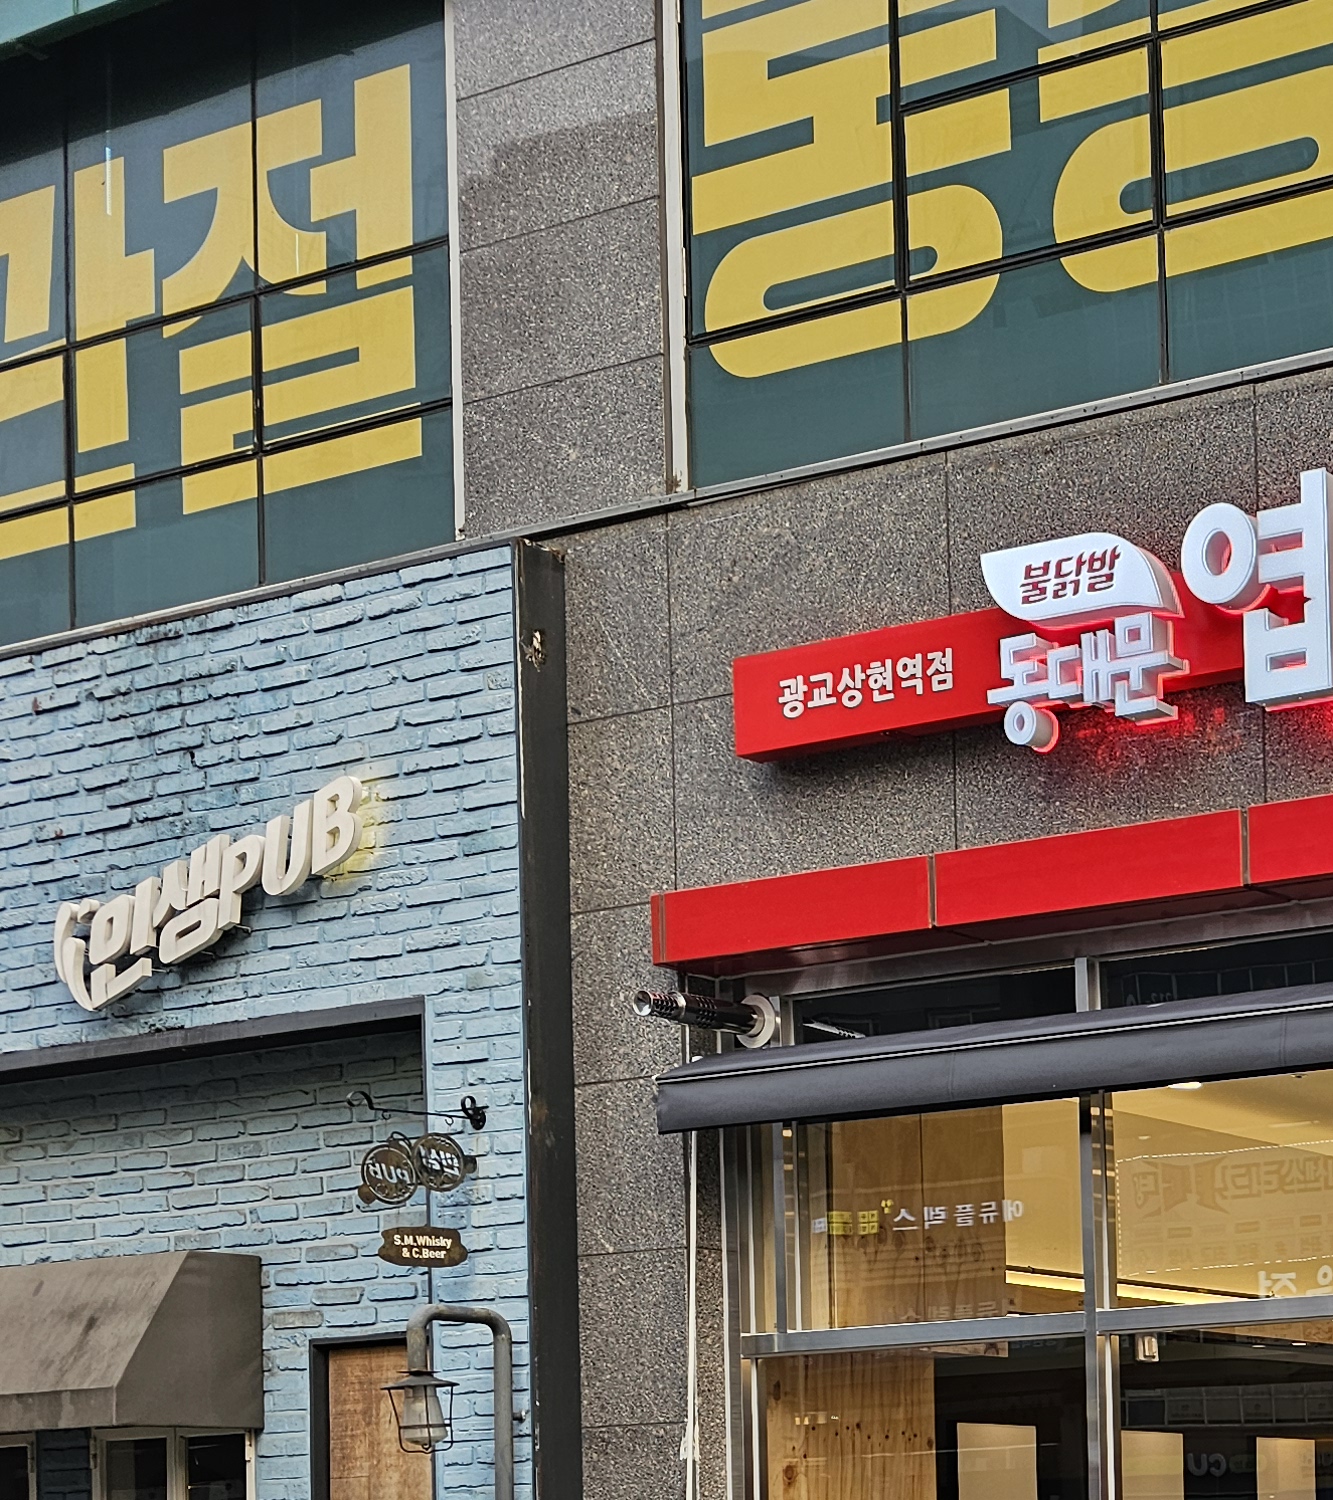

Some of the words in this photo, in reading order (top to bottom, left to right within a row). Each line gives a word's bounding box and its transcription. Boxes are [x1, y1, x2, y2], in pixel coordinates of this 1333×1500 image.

[1019, 544, 1121, 605] 불닭발
[777, 646, 955, 720] 광교상현역점
[987, 612, 1188, 750] 동대문
